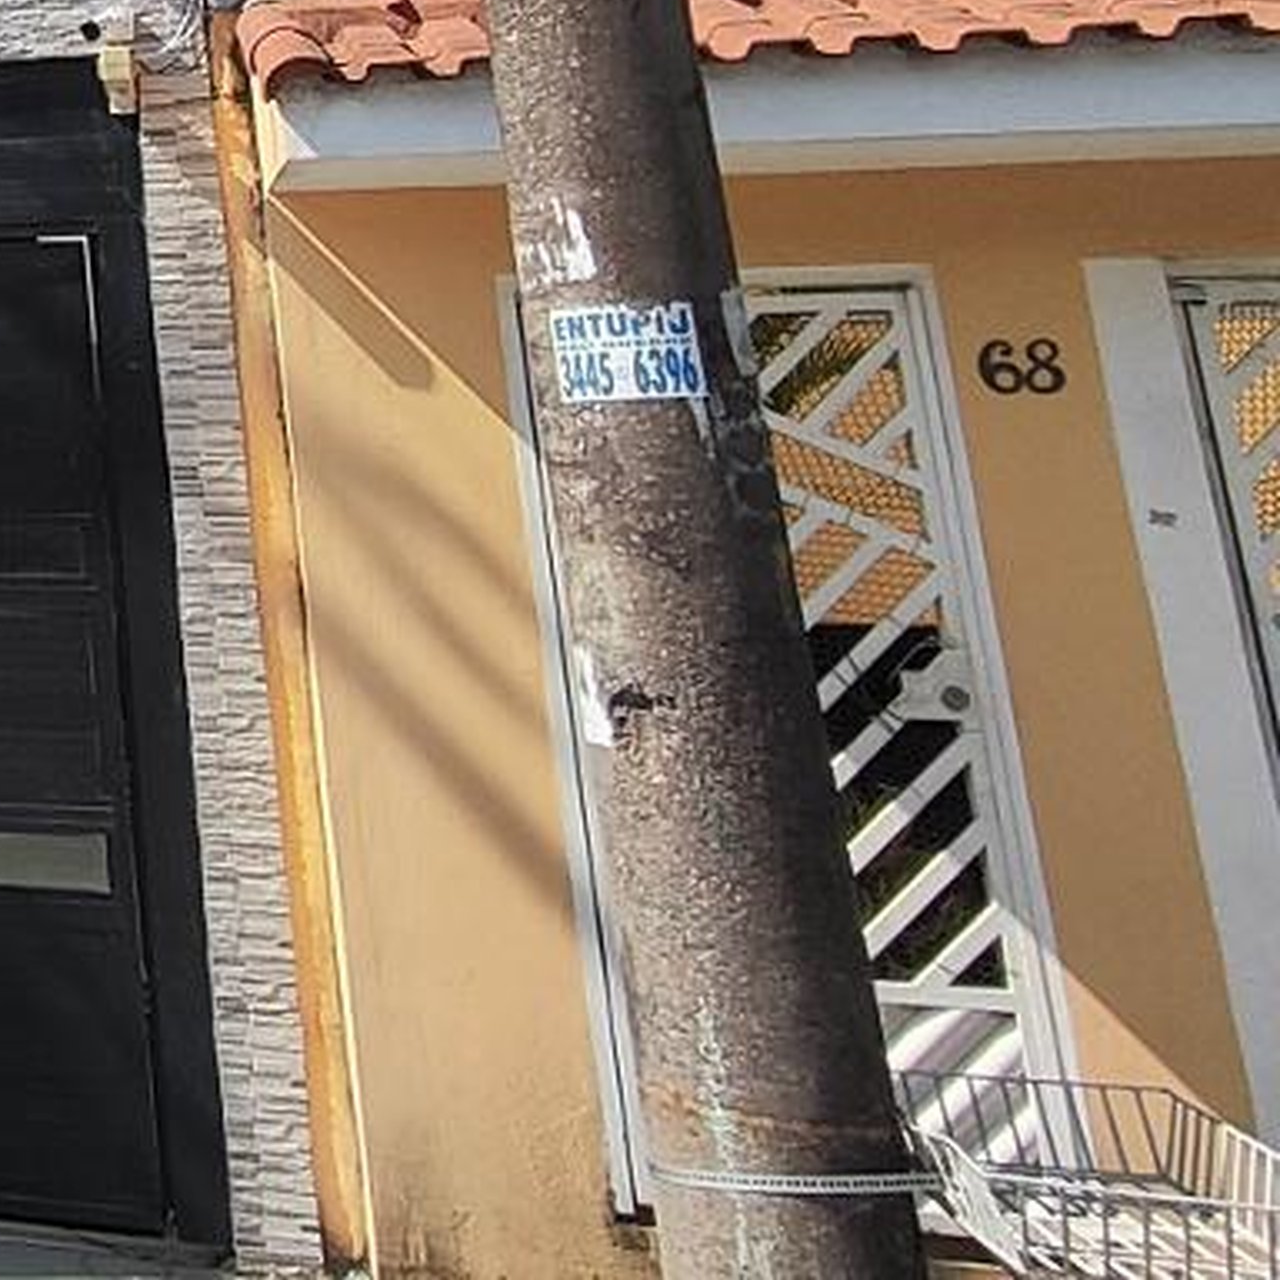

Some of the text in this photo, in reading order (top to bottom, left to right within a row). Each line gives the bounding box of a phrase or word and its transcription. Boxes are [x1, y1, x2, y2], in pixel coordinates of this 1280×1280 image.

[560, 347, 700, 398] 3445 6396
[978, 338, 1067, 395] 68
